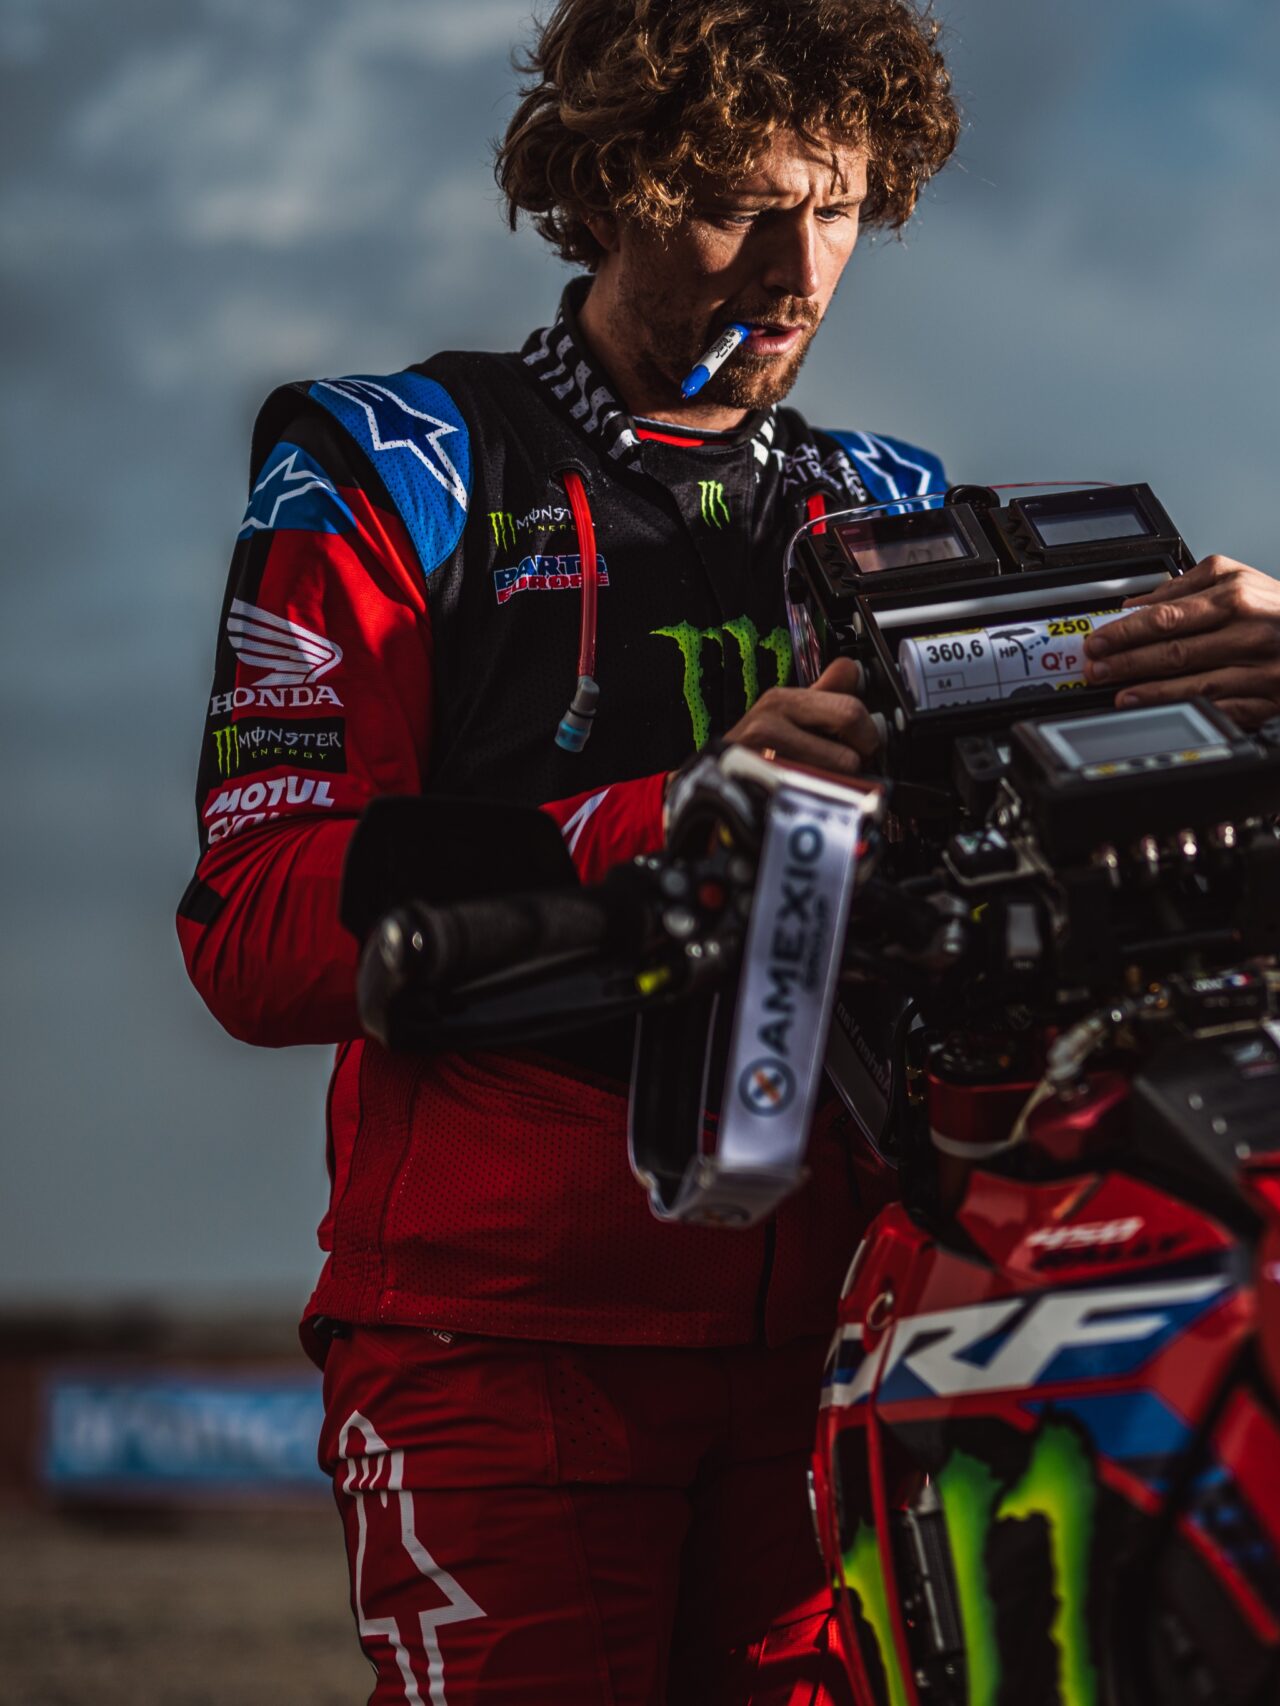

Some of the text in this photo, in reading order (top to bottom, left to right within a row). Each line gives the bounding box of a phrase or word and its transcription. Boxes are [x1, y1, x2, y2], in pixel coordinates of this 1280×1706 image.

[1049, 618, 1090, 637] 250
[927, 639, 984, 664] 360,6
[1000, 646, 1019, 659] HP
[210, 685, 344, 717] HONDA
[238, 726, 343, 749] MONSTER
[251, 747, 327, 760] ENERGY
[205, 776, 336, 818] MOTUL
[757, 824, 826, 1056] AMEXIO
